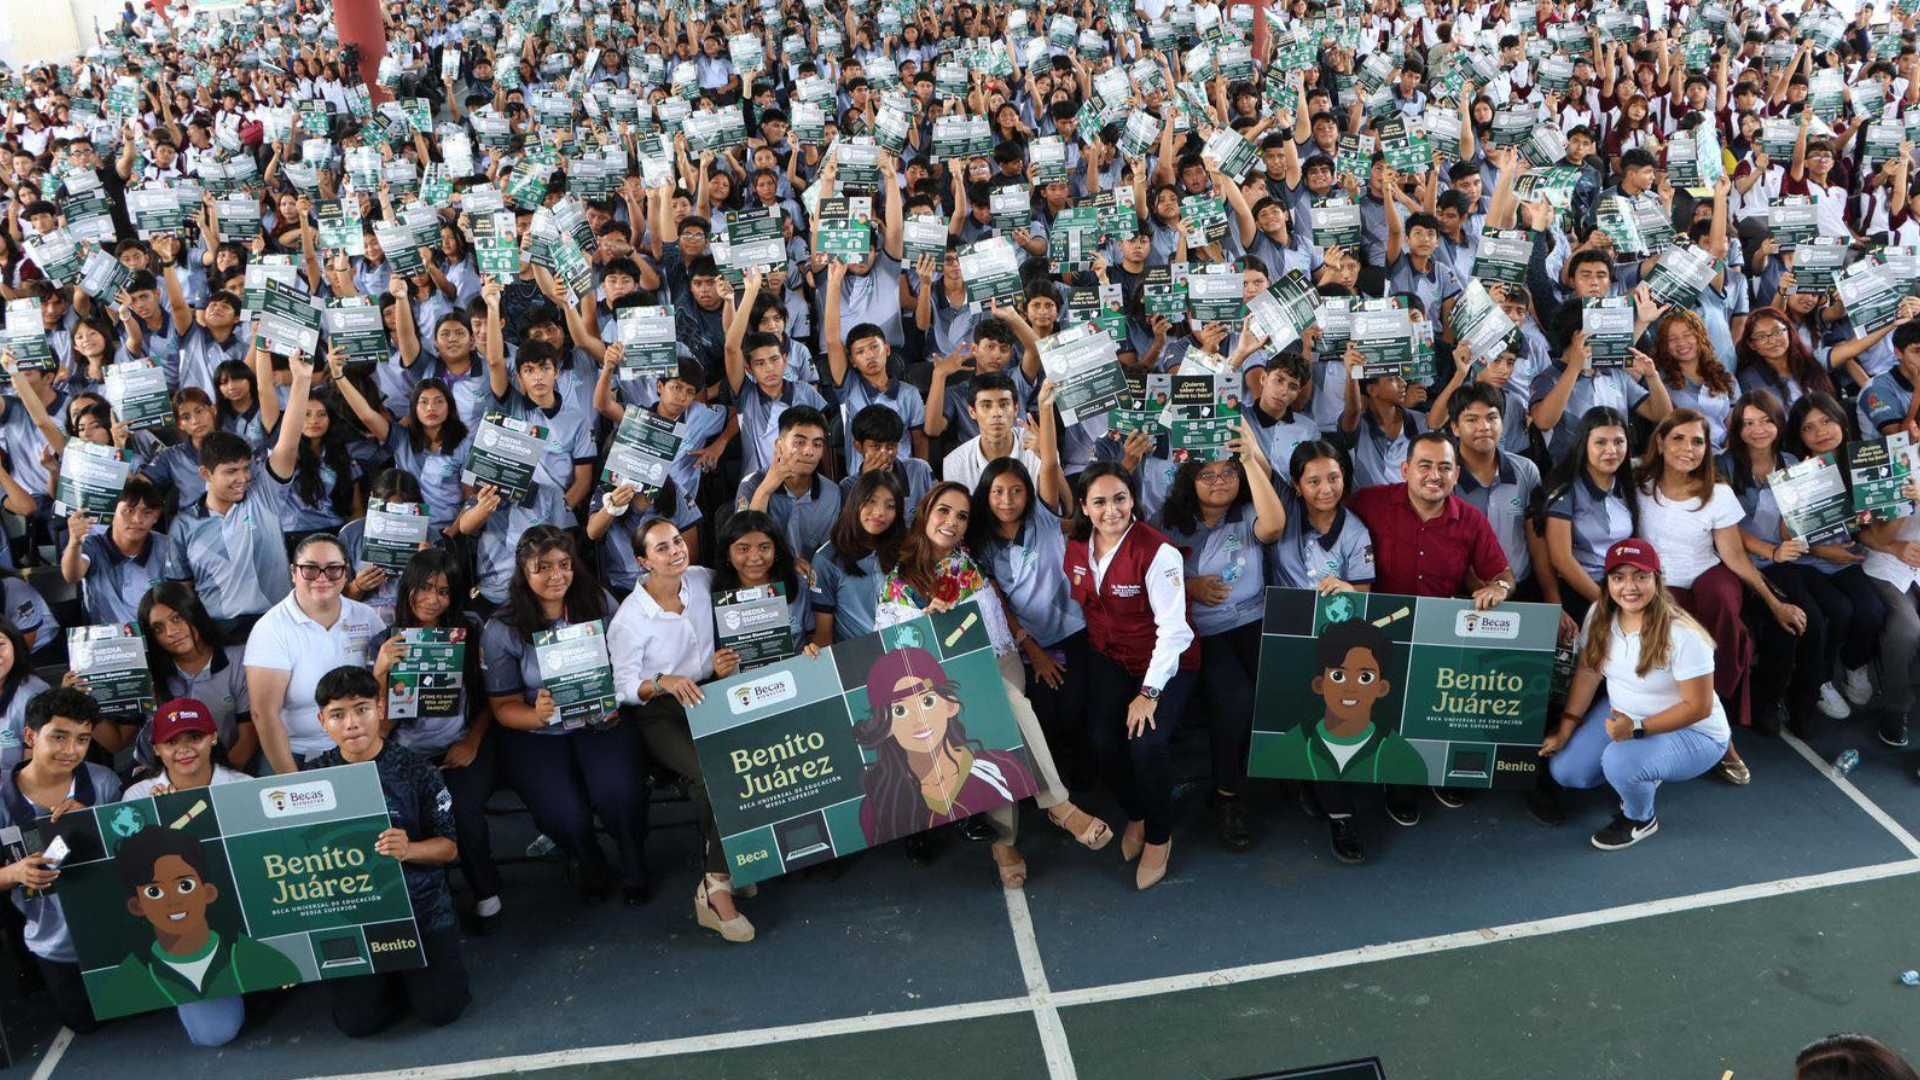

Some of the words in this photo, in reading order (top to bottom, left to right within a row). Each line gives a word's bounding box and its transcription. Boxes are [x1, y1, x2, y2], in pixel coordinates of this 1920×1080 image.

[1482, 617, 1510, 627] Becas
[1436, 667, 1523, 692] Benito
[754, 682, 785, 697] Becas
[1432, 691, 1521, 716] Juárez
[730, 731, 825, 774] Benito
[1496, 760, 1536, 772] Benito
[740, 755, 833, 798] Juárez
[290, 790, 324, 802] Becas
[764, 799, 786, 809] MEDIA
[263, 846, 365, 879] Benito
[736, 848, 769, 867] Beca
[272, 874, 374, 904] Juárez
[291, 901, 329, 912] UNIVERSAL
[300, 908, 322, 917] MEDIA
[324, 904, 357, 913] SUPERIOR
[371, 938, 417, 953] Benito
